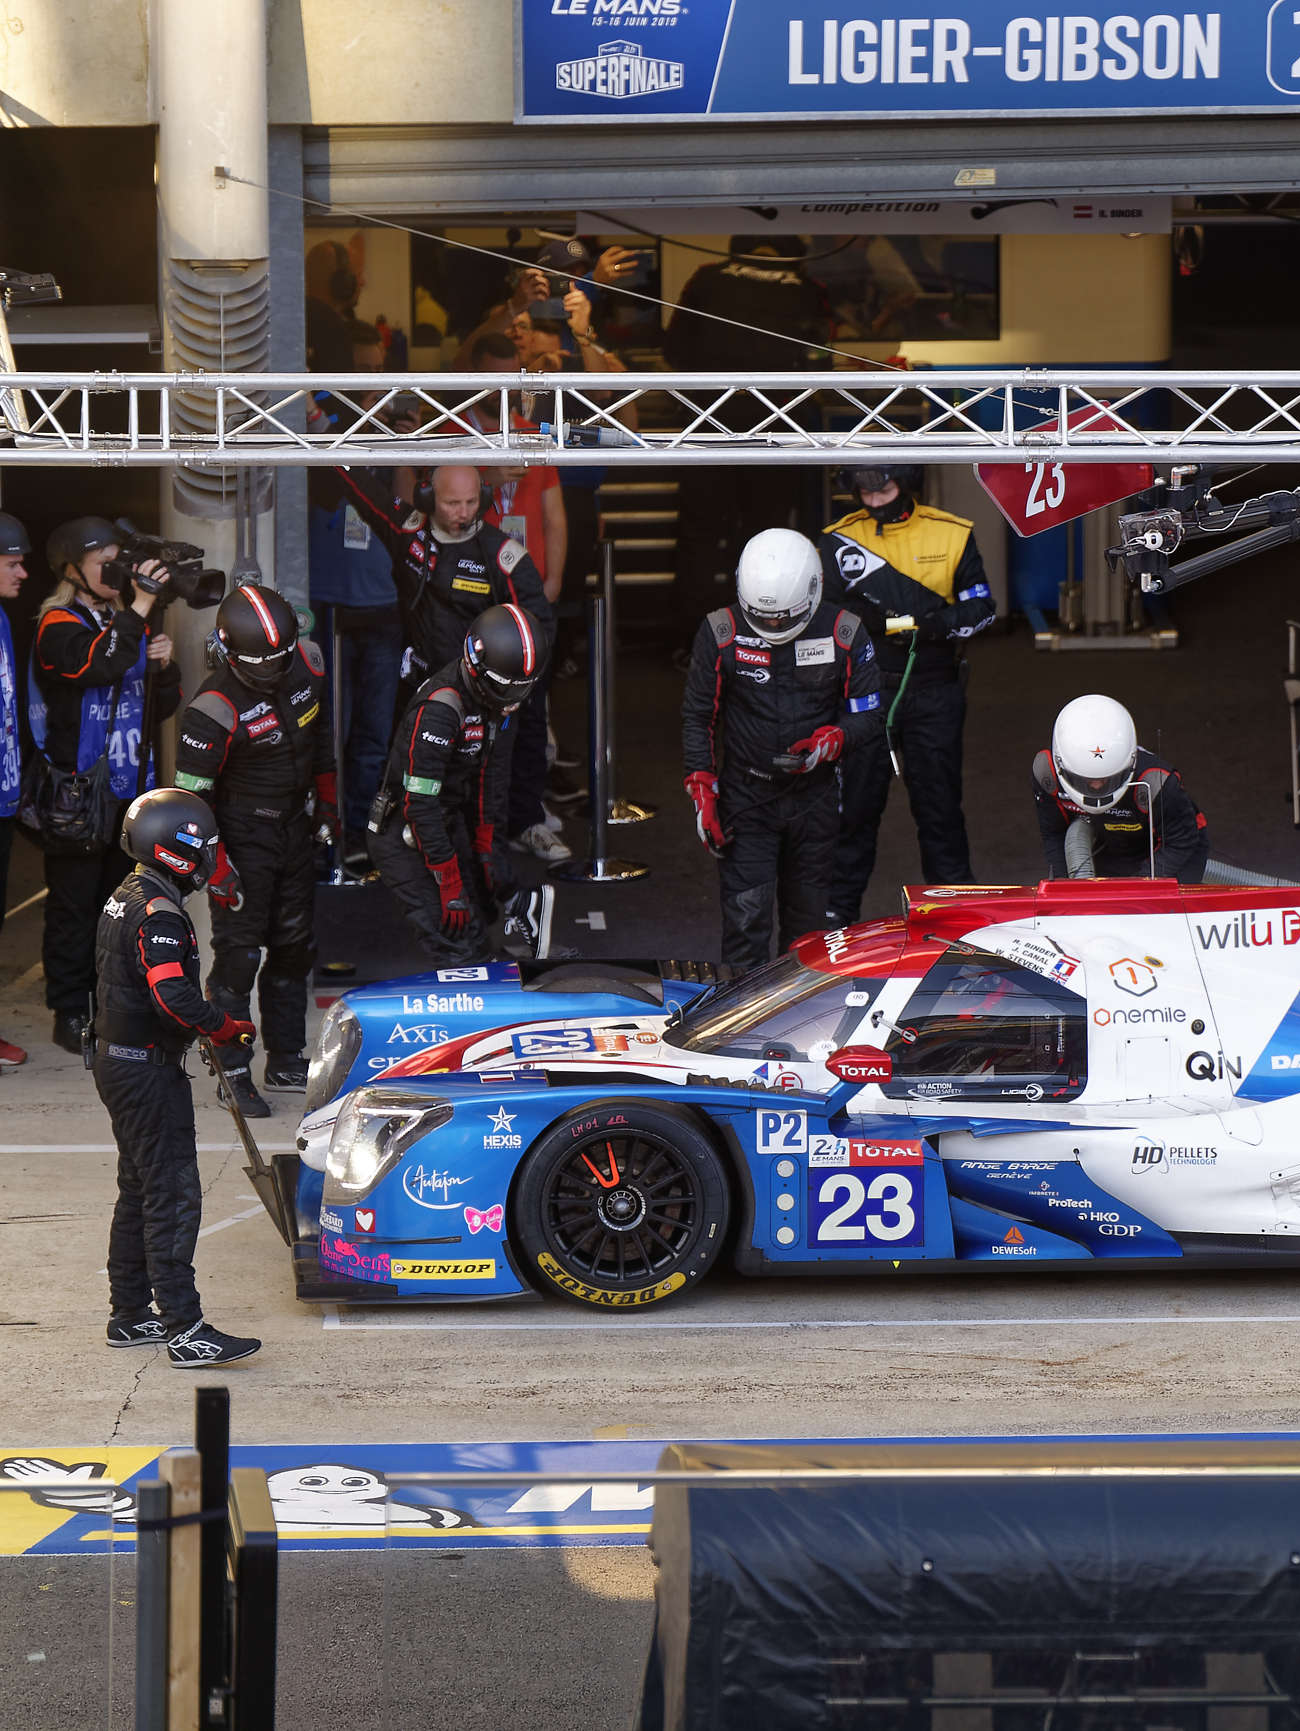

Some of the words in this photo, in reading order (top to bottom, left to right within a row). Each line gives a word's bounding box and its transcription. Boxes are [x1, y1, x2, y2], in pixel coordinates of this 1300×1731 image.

[551, 0, 587, 15] LE
[592, 17, 621, 26] 15-16
[623, 17, 648, 26] JUIN
[651, 17, 678, 26] 2019
[788, 13, 1221, 85] LIGIER-GIBSON
[558, 56, 681, 97] SUPERFINALE
[1026, 462, 1066, 518] 23
[737, 650, 769, 663] TOTAL
[247, 719, 277, 738] TOTAL
[823, 927, 849, 964] OTAL
[1024, 940, 1057, 959] BINDER
[1006, 952, 1045, 974] STEVENS
[1021, 948, 1049, 966] CANAL
[403, 995, 424, 1015] La
[427, 993, 485, 1014] Sarthe
[519, 1030, 591, 1056] 23
[838, 1064, 890, 1077] TOTAL
[761, 1112, 802, 1147] P2
[483, 1134, 523, 1146] HEXIS
[853, 1143, 921, 1158] TOTAL
[1132, 1147, 1163, 1164] HD
[1169, 1147, 1218, 1159] PELLETS
[817, 1173, 916, 1241] 23
[1048, 1199, 1093, 1209] ProTech
[1090, 1212, 1120, 1222] HKO
[1098, 1224, 1142, 1237] GDP
[992, 1246, 1038, 1256] DEWESoft
[410, 1263, 492, 1275] DUNLOP
[540, 1261, 659, 1305] DUNLOP
